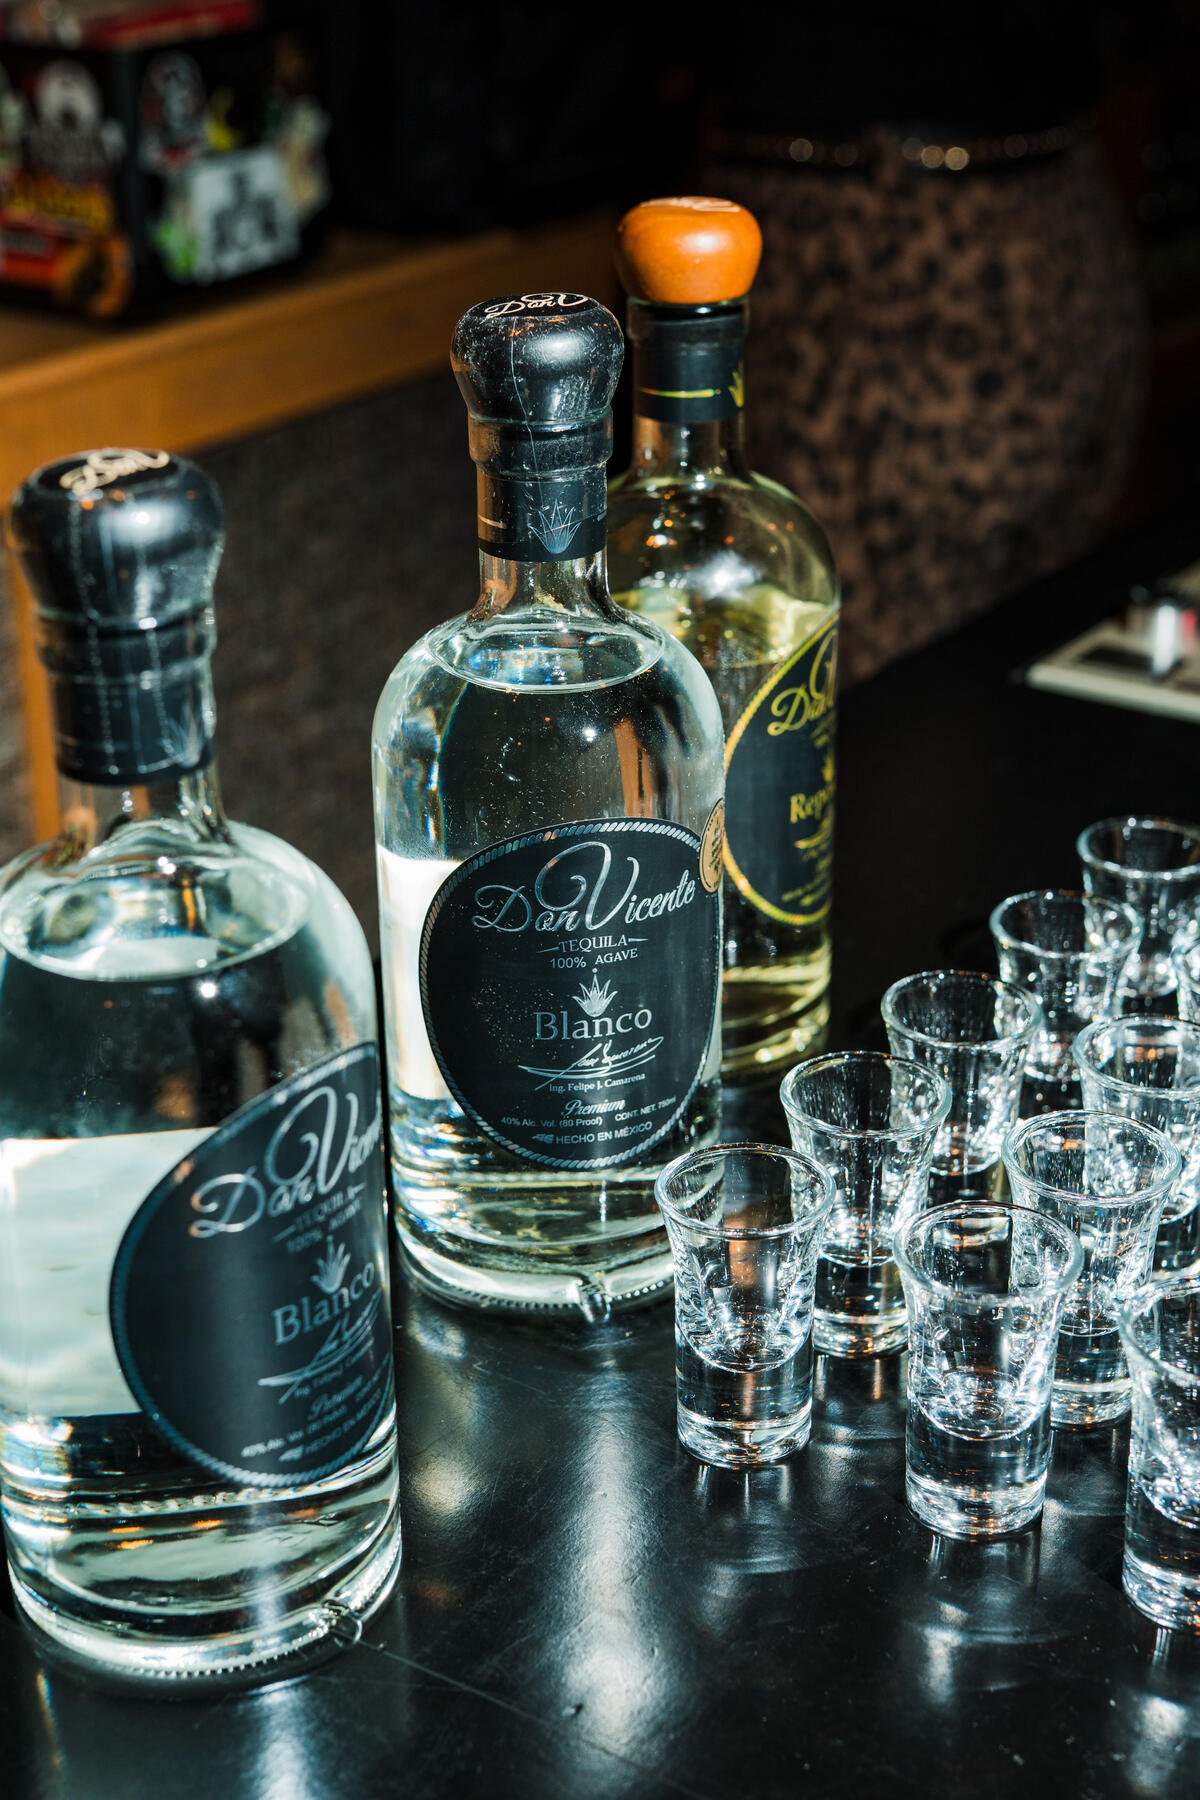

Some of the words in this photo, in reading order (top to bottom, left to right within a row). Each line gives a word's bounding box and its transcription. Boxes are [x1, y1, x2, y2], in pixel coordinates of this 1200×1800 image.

[472, 885, 581, 932] Don
[534, 841, 696, 931] Vicente
[558, 934, 628, 953] TEQUILA
[550, 956, 587, 969] 100%
[594, 948, 638, 965] AGAVE
[535, 1008, 652, 1041] Blanco
[567, 1082, 595, 1093] Felipe
[604, 1073, 646, 1088] Camarena
[561, 1099, 626, 1116] Premium
[555, 1133, 595, 1145] HECHO
[597, 1131, 613, 1142] EN
[614, 1121, 653, 1139] MÉXICO
[188, 1166, 315, 1238] Don
[272, 1262, 375, 1346] Blanco
